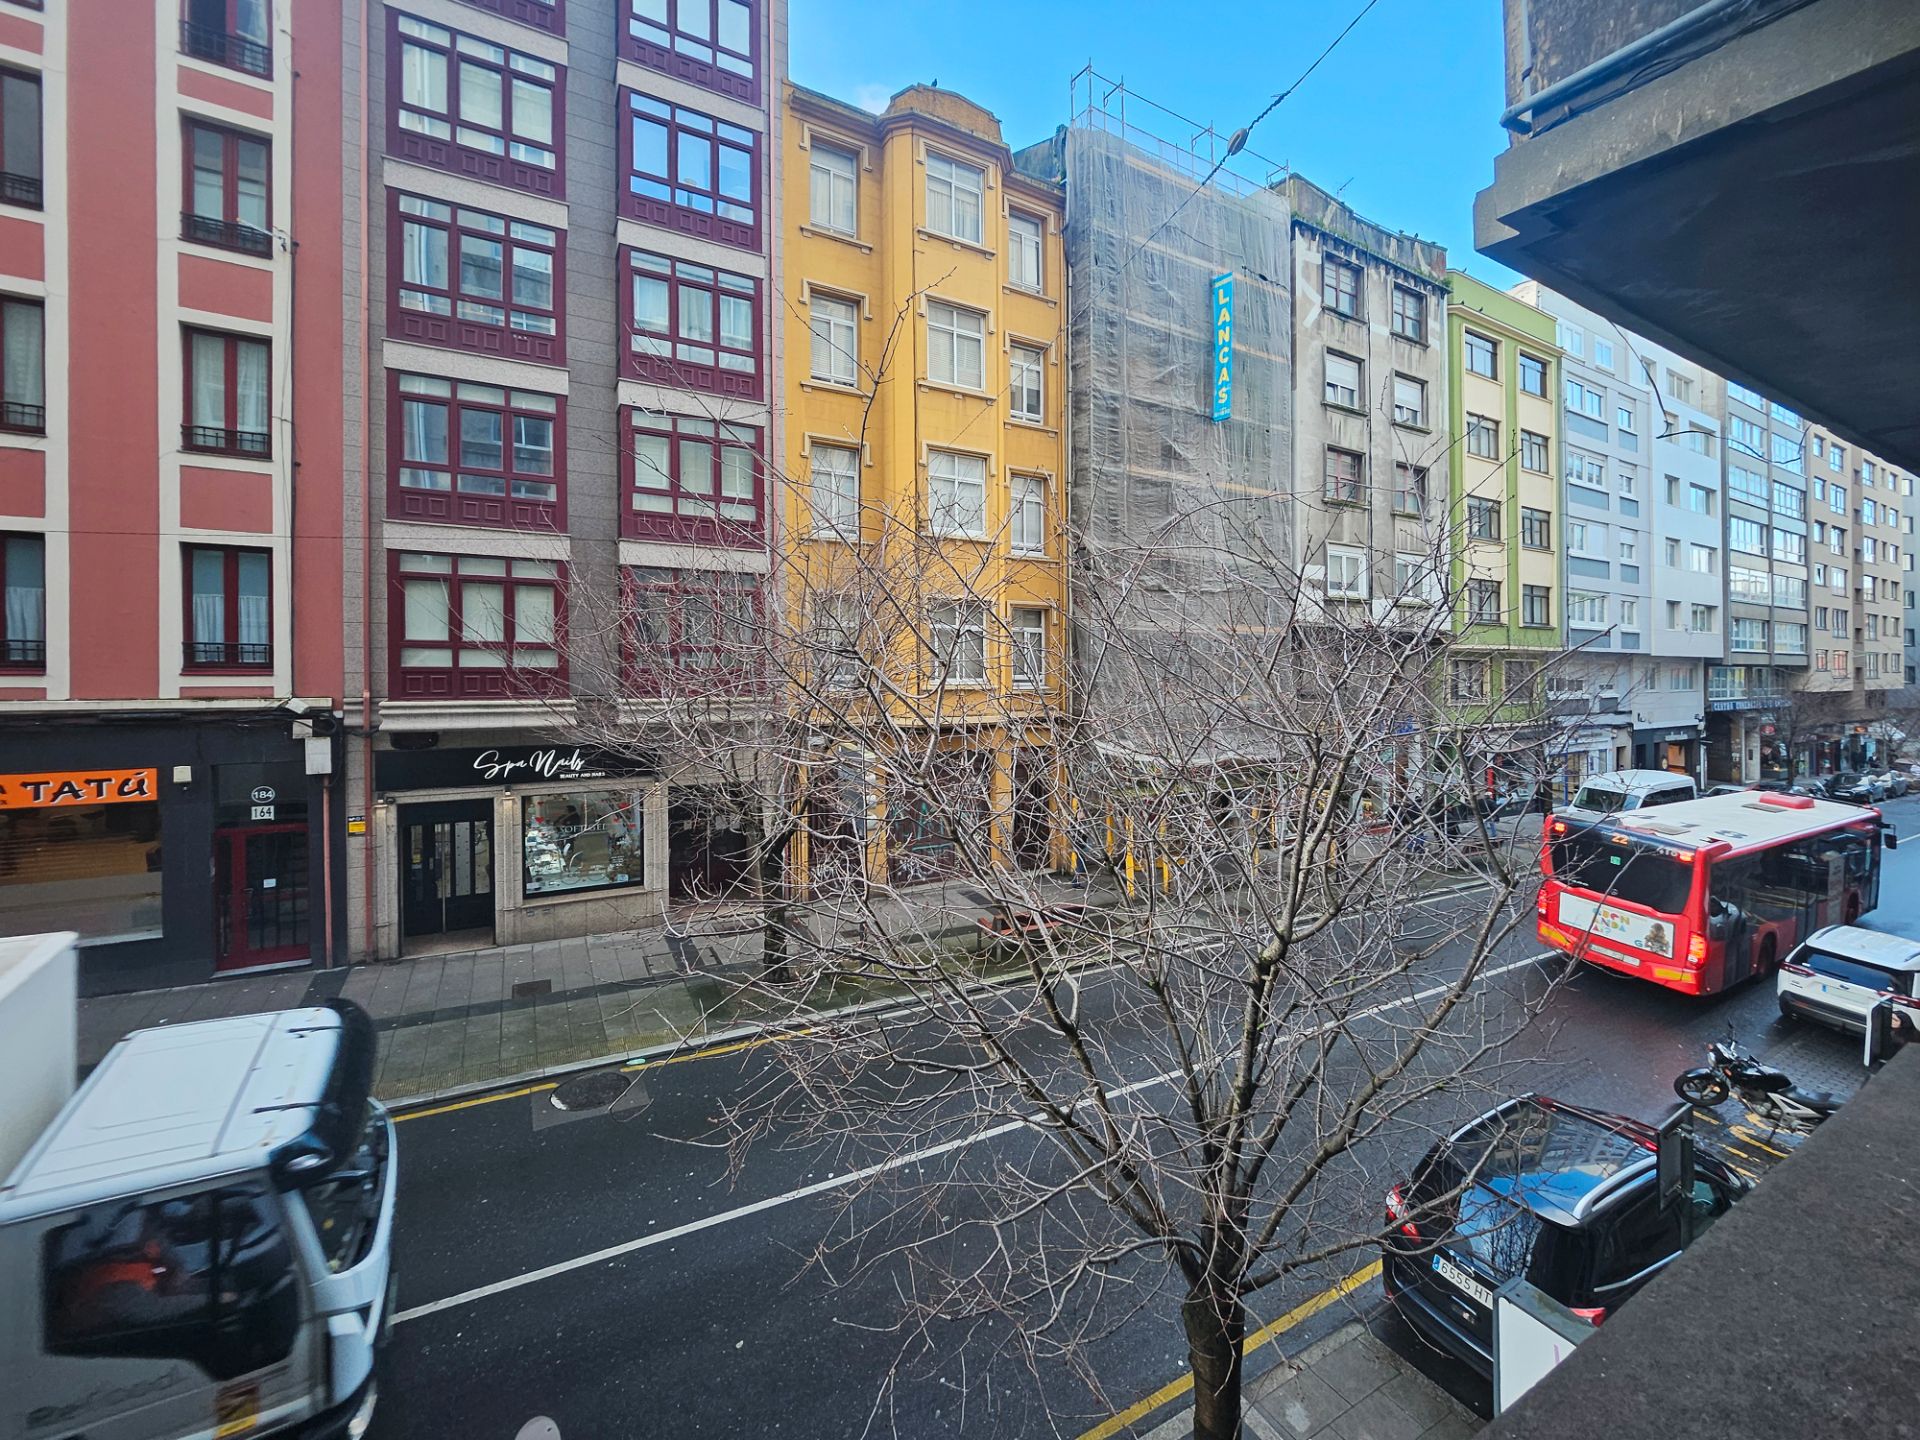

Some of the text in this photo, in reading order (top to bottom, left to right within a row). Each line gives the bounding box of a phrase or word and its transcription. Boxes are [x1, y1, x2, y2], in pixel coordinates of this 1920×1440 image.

[1217, 288, 1231, 404] LANCAS
[473, 749, 585, 779] Spa Nails
[253, 790, 273, 799] 184
[254, 807, 272, 818] 164
[1611, 832, 1630, 845] 22
[1441, 1262, 1492, 1303] 6555 HT
